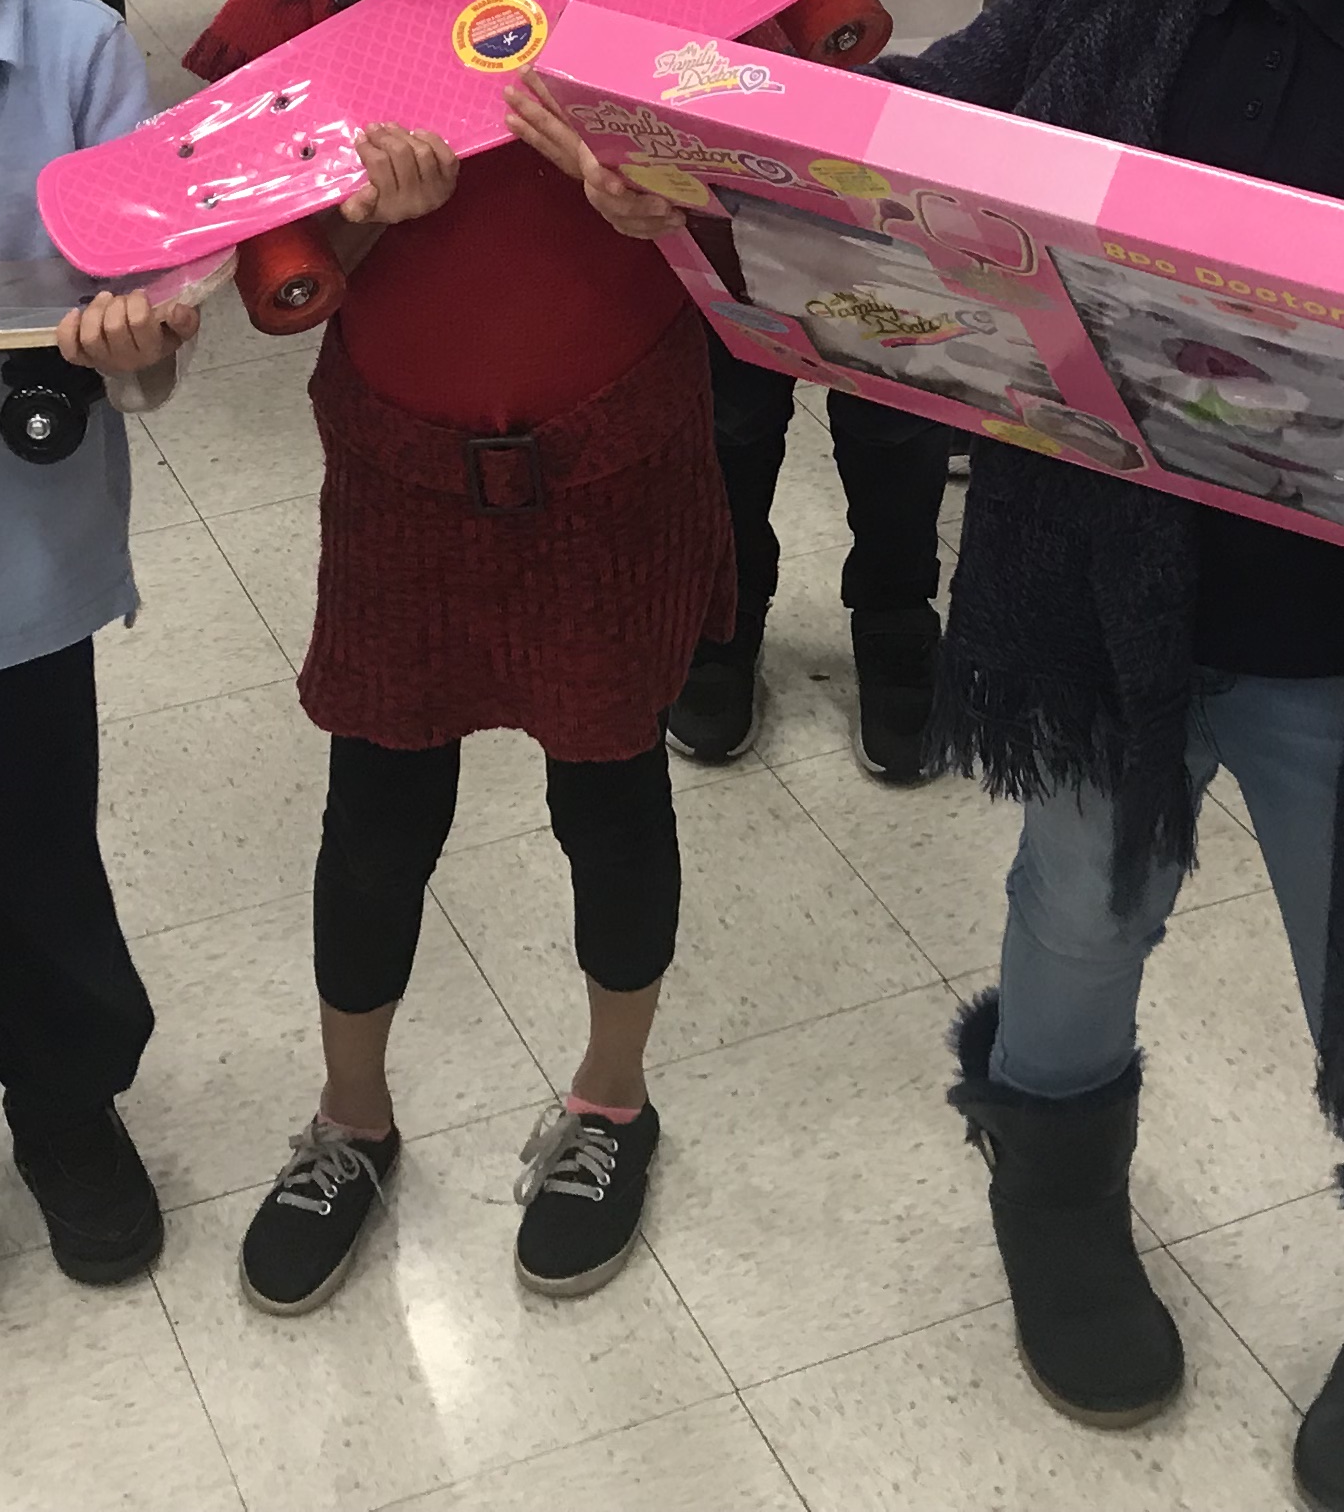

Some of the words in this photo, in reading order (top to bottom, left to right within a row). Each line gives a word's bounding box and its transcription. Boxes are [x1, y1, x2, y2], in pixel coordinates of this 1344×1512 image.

[656, 43, 717, 76] Family
[676, 68, 740, 92] Doctor
[571, 105, 677, 145] Family
[633, 135, 738, 164] Doctor
[806, 291, 899, 322] Family
[861, 308, 958, 335] Doctor
